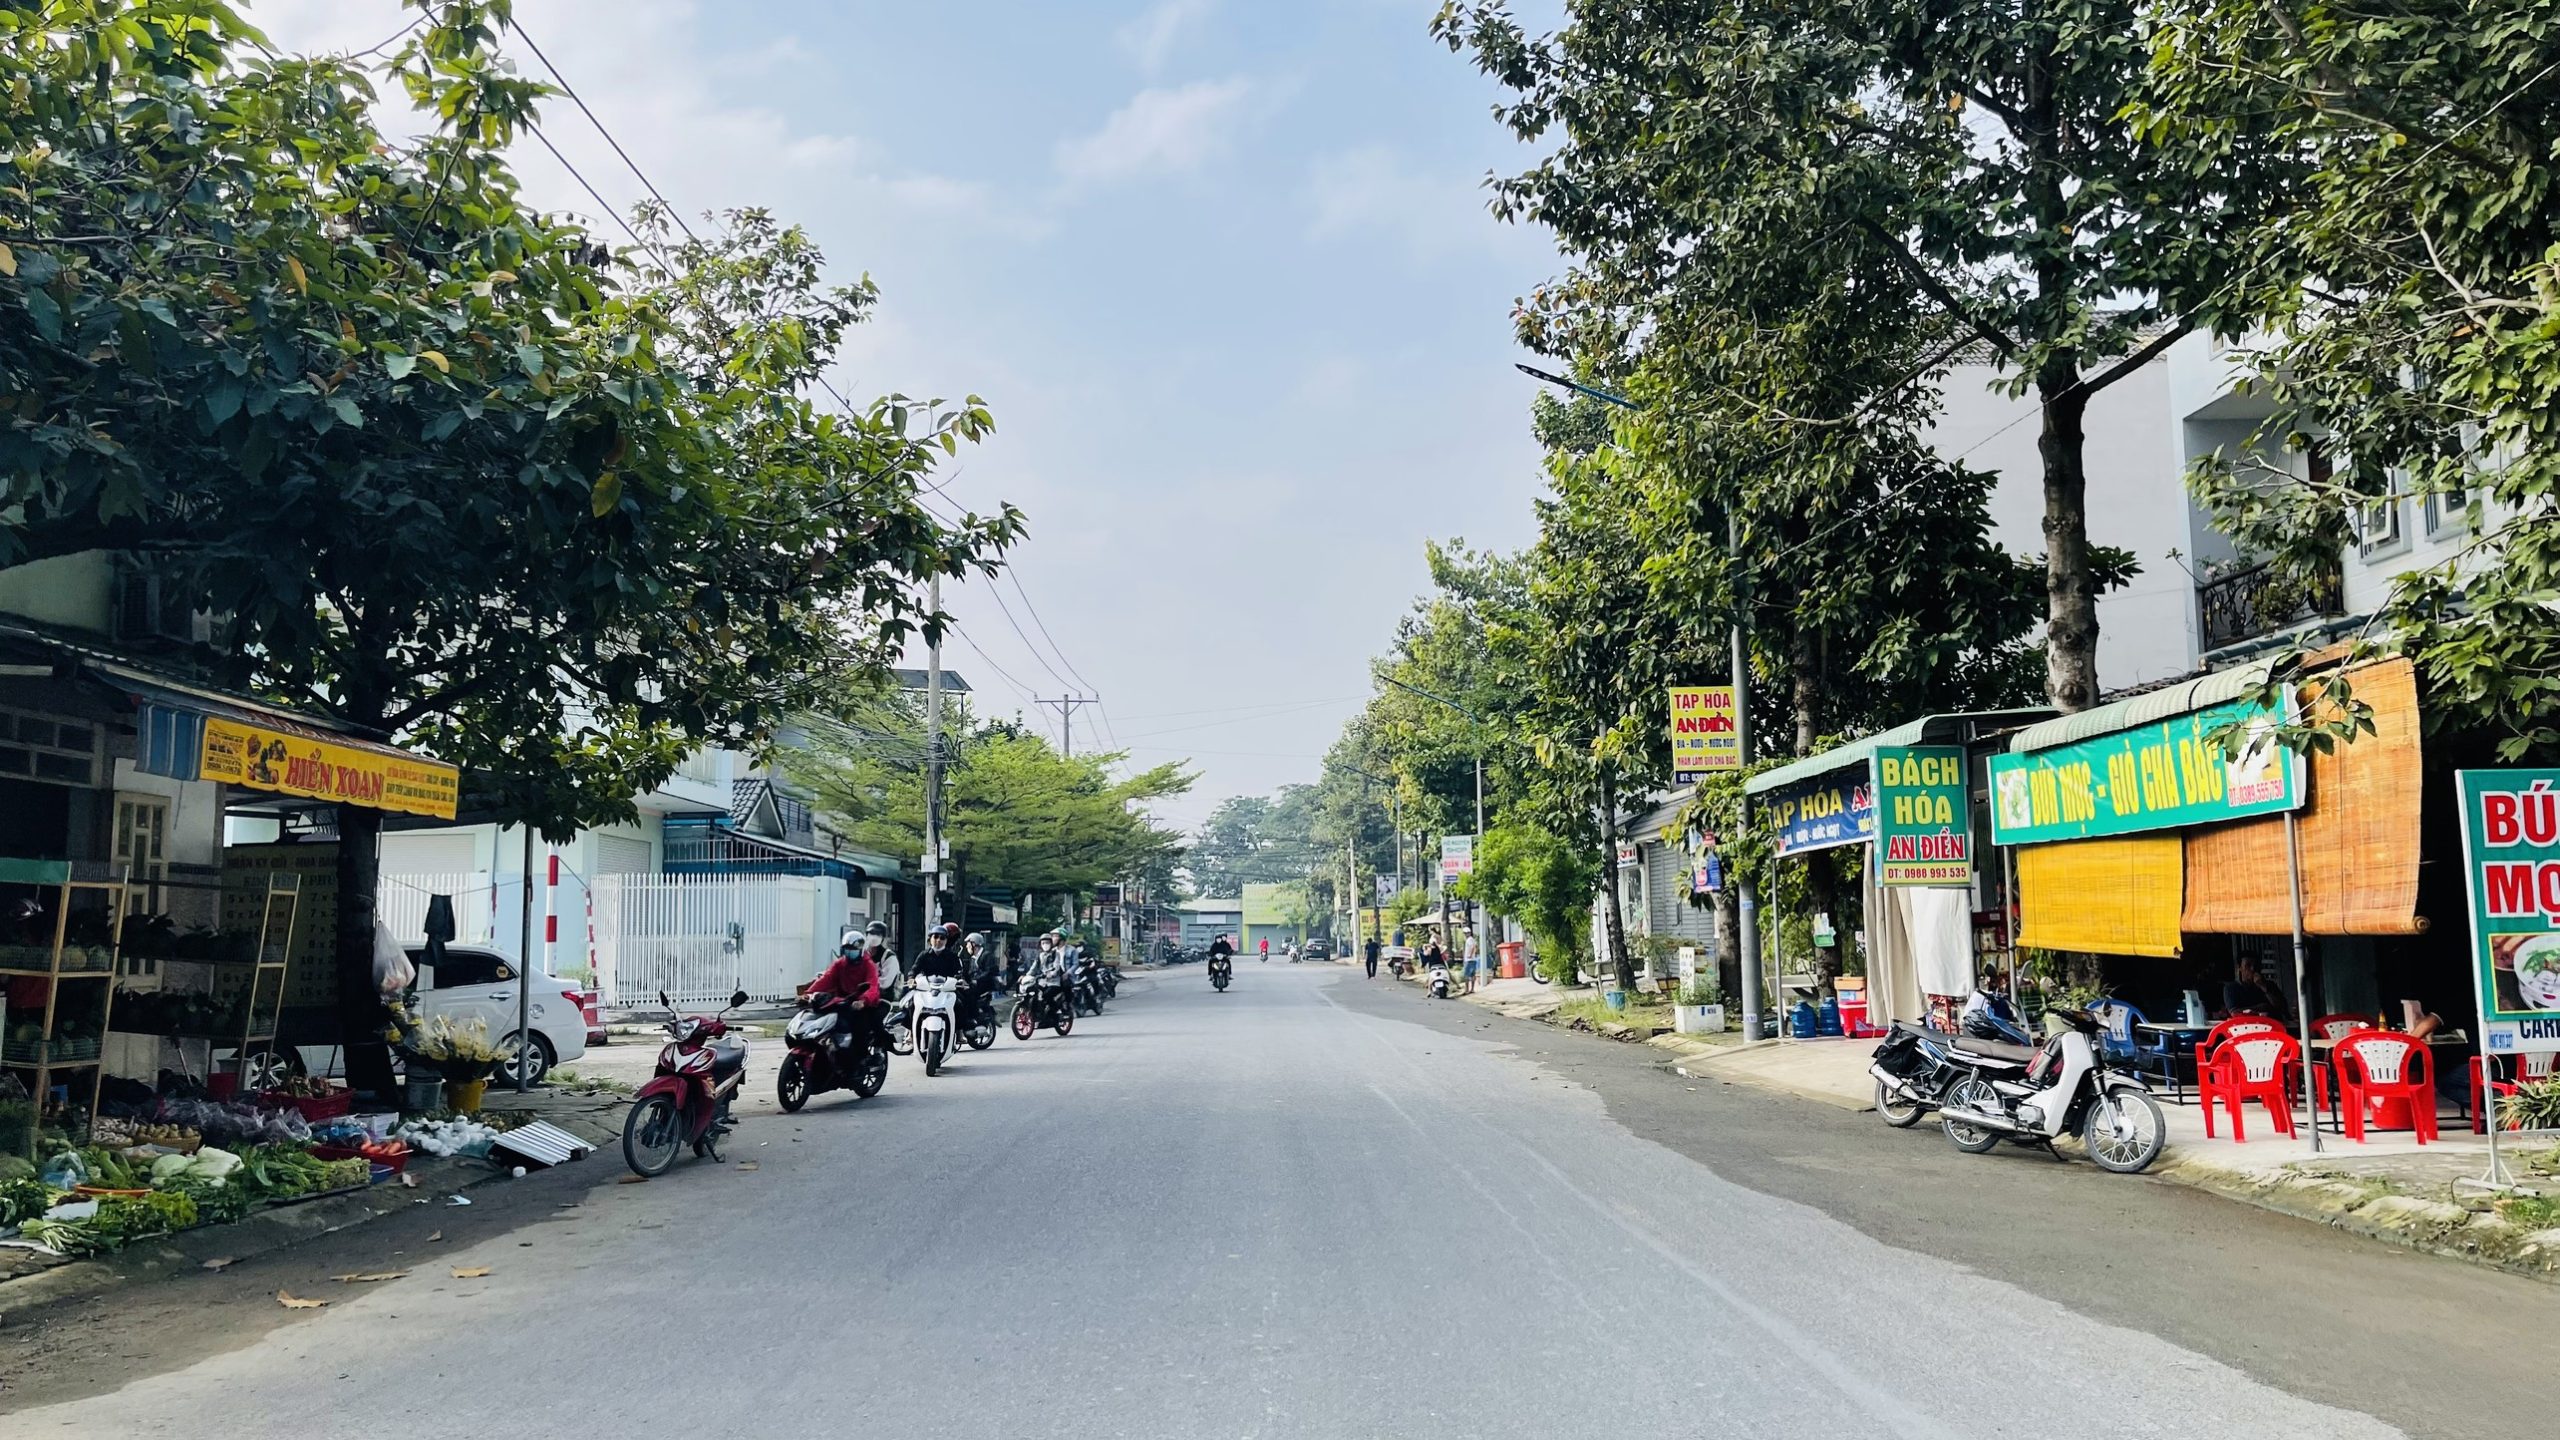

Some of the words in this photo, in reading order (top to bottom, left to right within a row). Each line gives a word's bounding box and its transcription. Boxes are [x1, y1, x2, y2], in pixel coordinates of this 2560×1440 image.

[1673, 694, 1699, 713] TẠP
[335, 764, 385, 802] XOAN
[1881, 751, 1960, 787] BÁCH
[1799, 784, 1844, 822] HÓA
[1894, 790, 1953, 825] HÓA
[2480, 779, 2560, 848] BÚ
[1887, 834, 1917, 860] AN
[1949, 866, 1967, 878] 535
